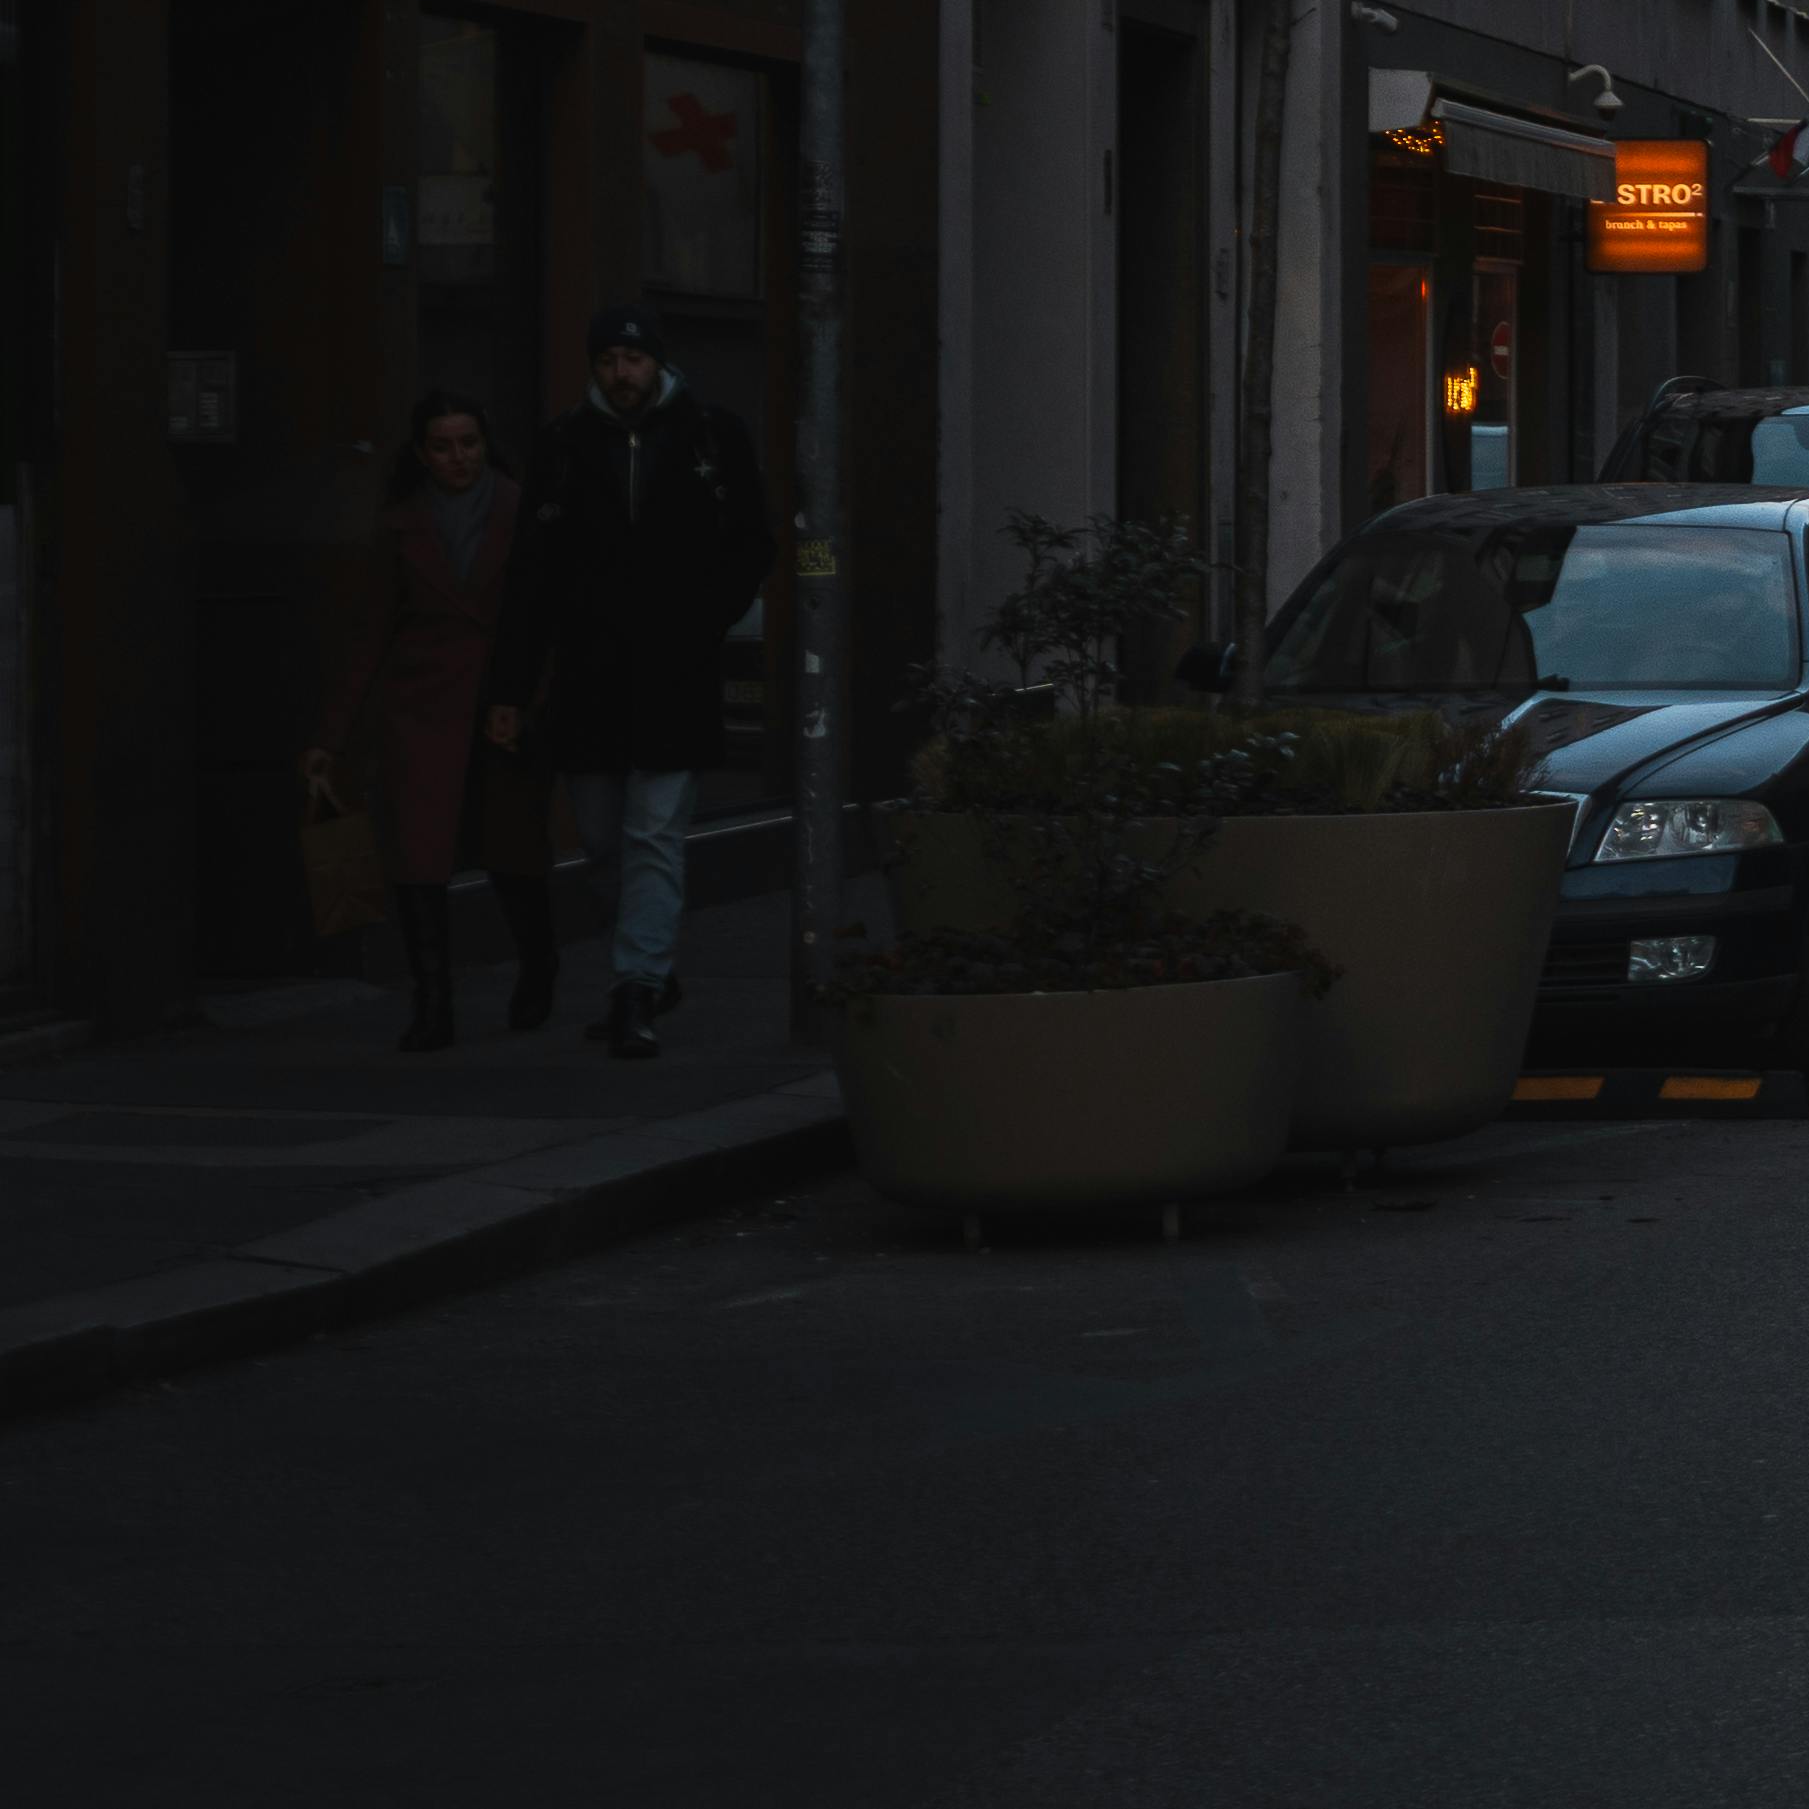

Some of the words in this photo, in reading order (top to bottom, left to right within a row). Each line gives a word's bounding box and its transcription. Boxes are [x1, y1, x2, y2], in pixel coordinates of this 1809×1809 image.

[1605, 219, 1645, 230] brunch
[1646, 220, 1656, 230] &
[1658, 220, 1688, 231] tapas
